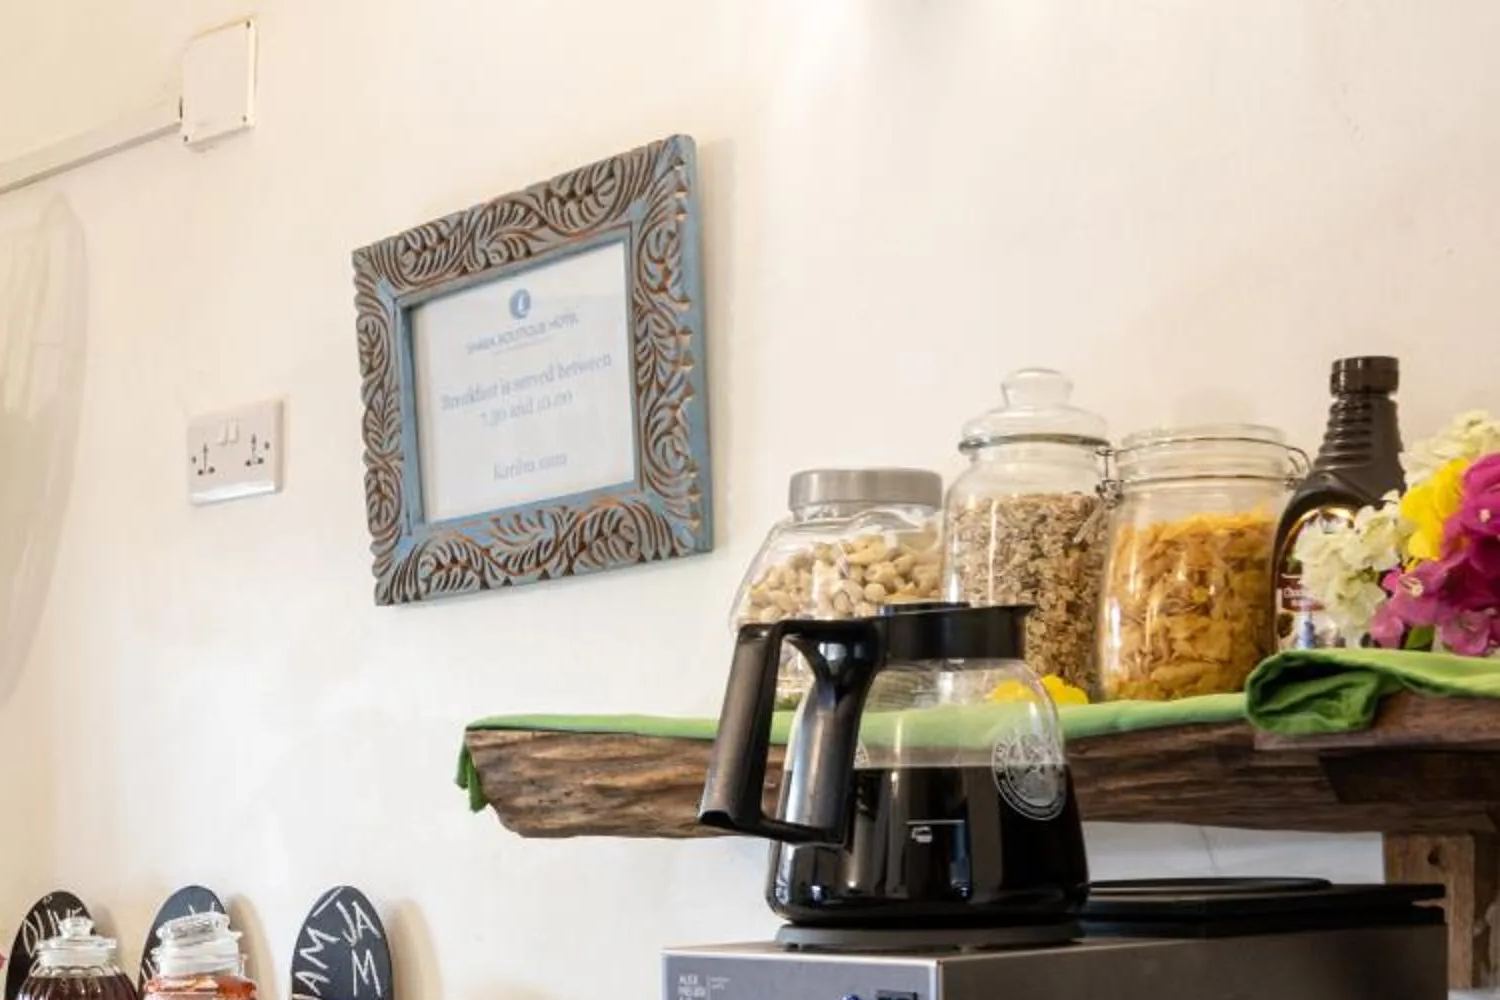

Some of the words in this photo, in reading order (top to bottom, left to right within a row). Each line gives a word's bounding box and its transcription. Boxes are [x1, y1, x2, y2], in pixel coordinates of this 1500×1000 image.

[441, 383, 498, 411] Breakfast
[512, 366, 555, 388] served
[557, 354, 611, 379] between
[510, 397, 534, 418] and
